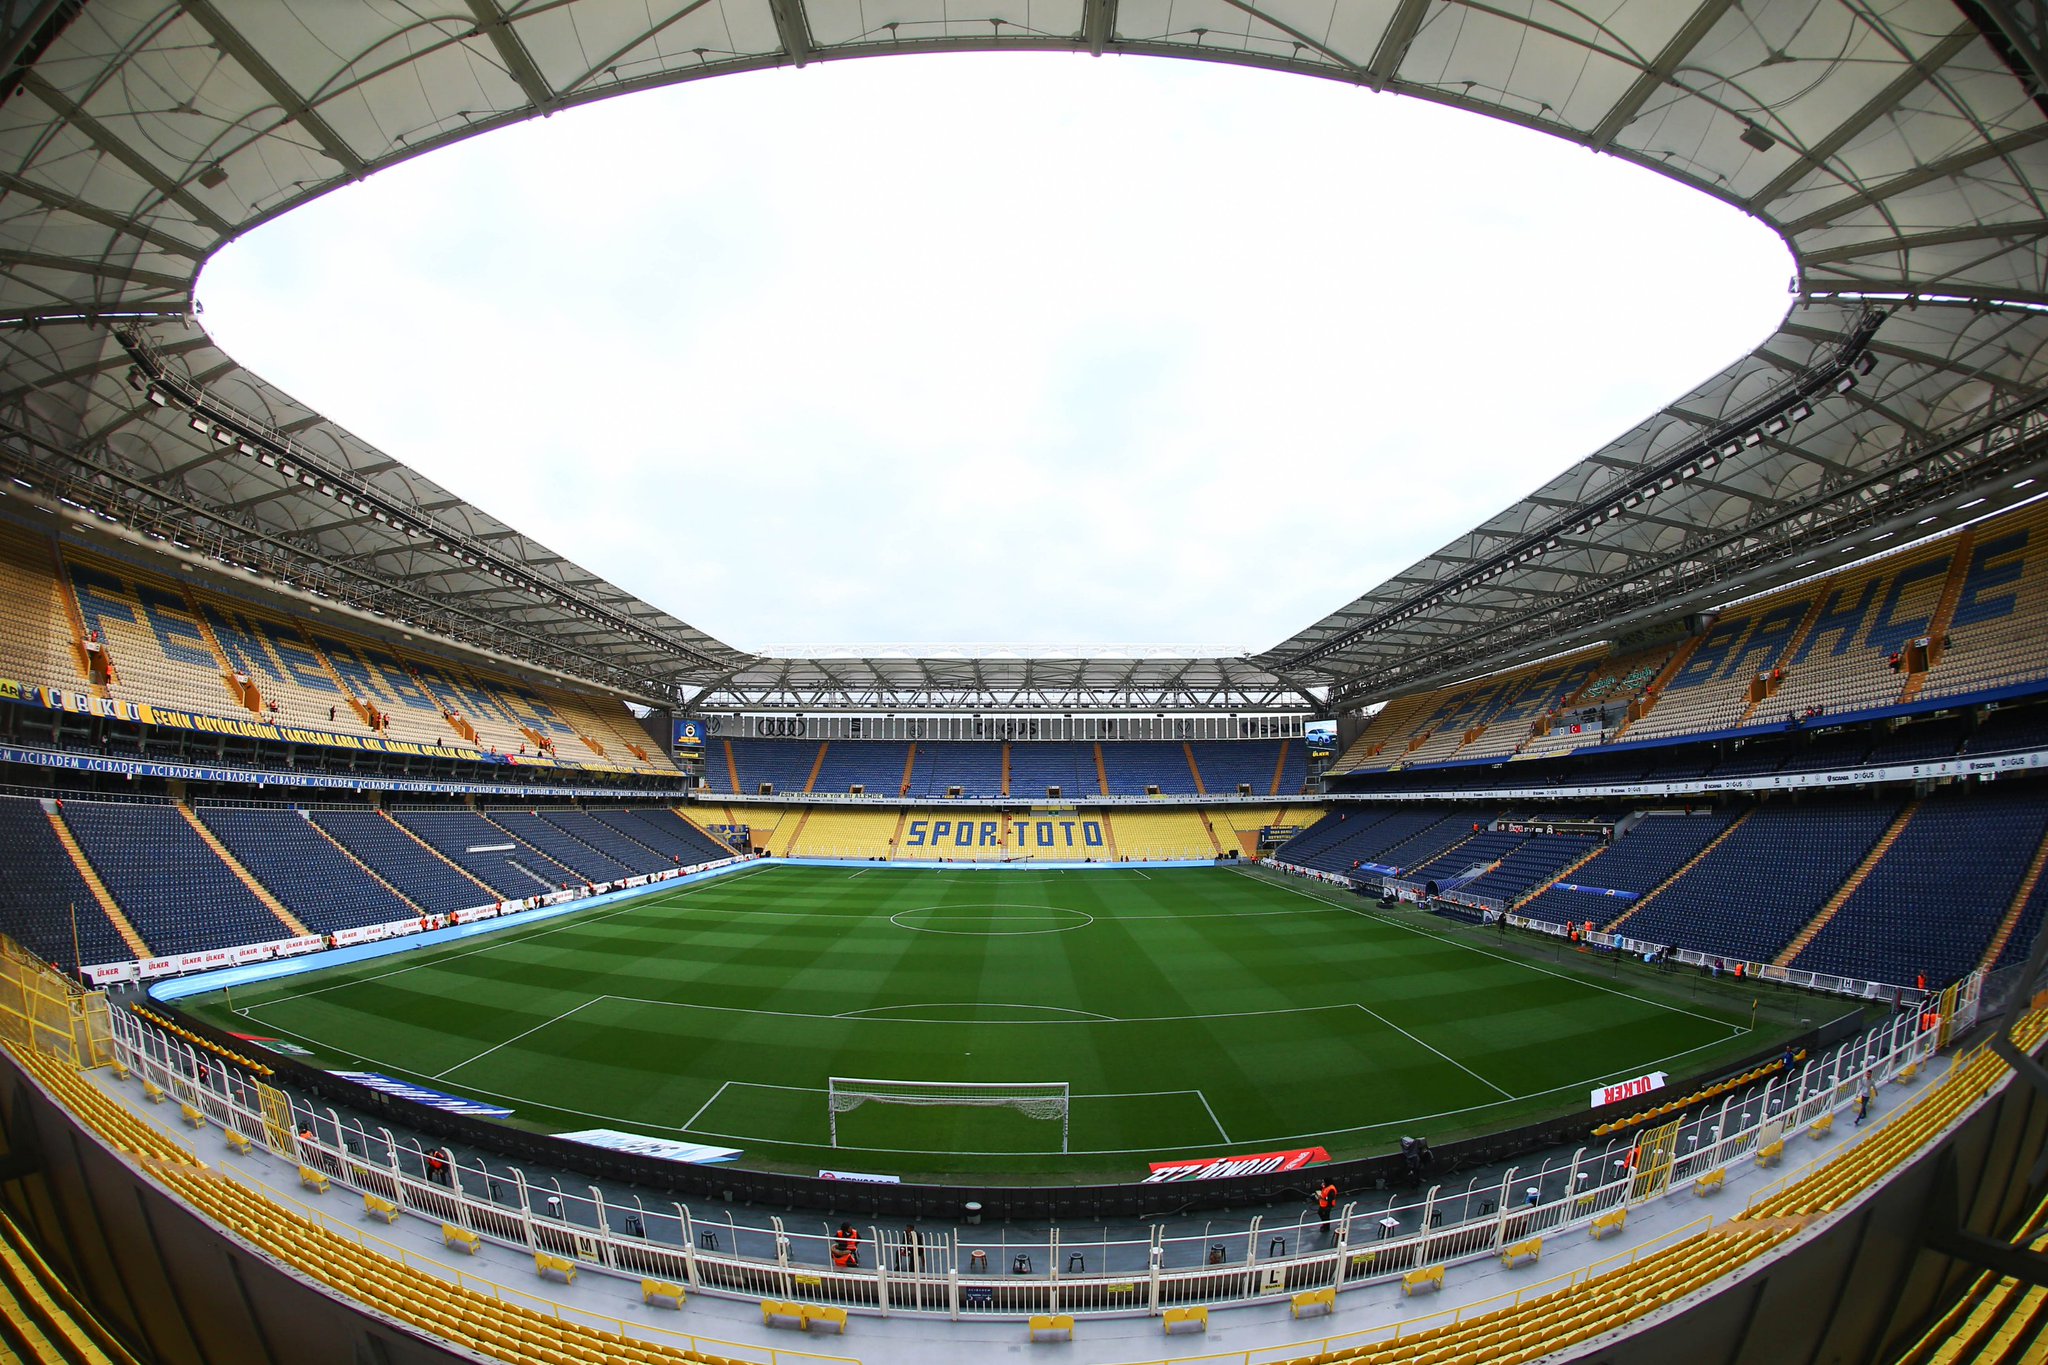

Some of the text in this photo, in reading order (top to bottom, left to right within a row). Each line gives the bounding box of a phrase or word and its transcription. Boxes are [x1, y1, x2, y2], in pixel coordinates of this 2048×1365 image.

[20, 752, 79, 768] ACIBADEM
[87, 760, 142, 774] ACIBADEM
[150, 766, 202, 779] ACIBADEM
[209, 771, 257, 783] ACIBADEM
[263, 775, 307, 785] ACIBADEM
[313, 779, 354, 788] ACIBADEM
[358, 781, 394, 790] ACIBADEM
[907, 821, 998, 846] SPOR
[1013, 822, 1104, 847] TOTO
[342, 932, 357, 940] ÜLKER
[286, 941, 302, 949] ÜLKER
[304, 938, 320, 946] ÜLKER
[239, 948, 258, 957] ÜLKER
[262, 944, 280, 953] ÜLKER
[182, 956, 202, 965] ÜLKER
[206, 953, 225, 962] ÜLKER
[148, 961, 169, 970] ÜLKER
[97, 967, 119, 977] ÜLKER
[579, 1236, 593, 1252] M
[1270, 1270, 1278, 1284] L
